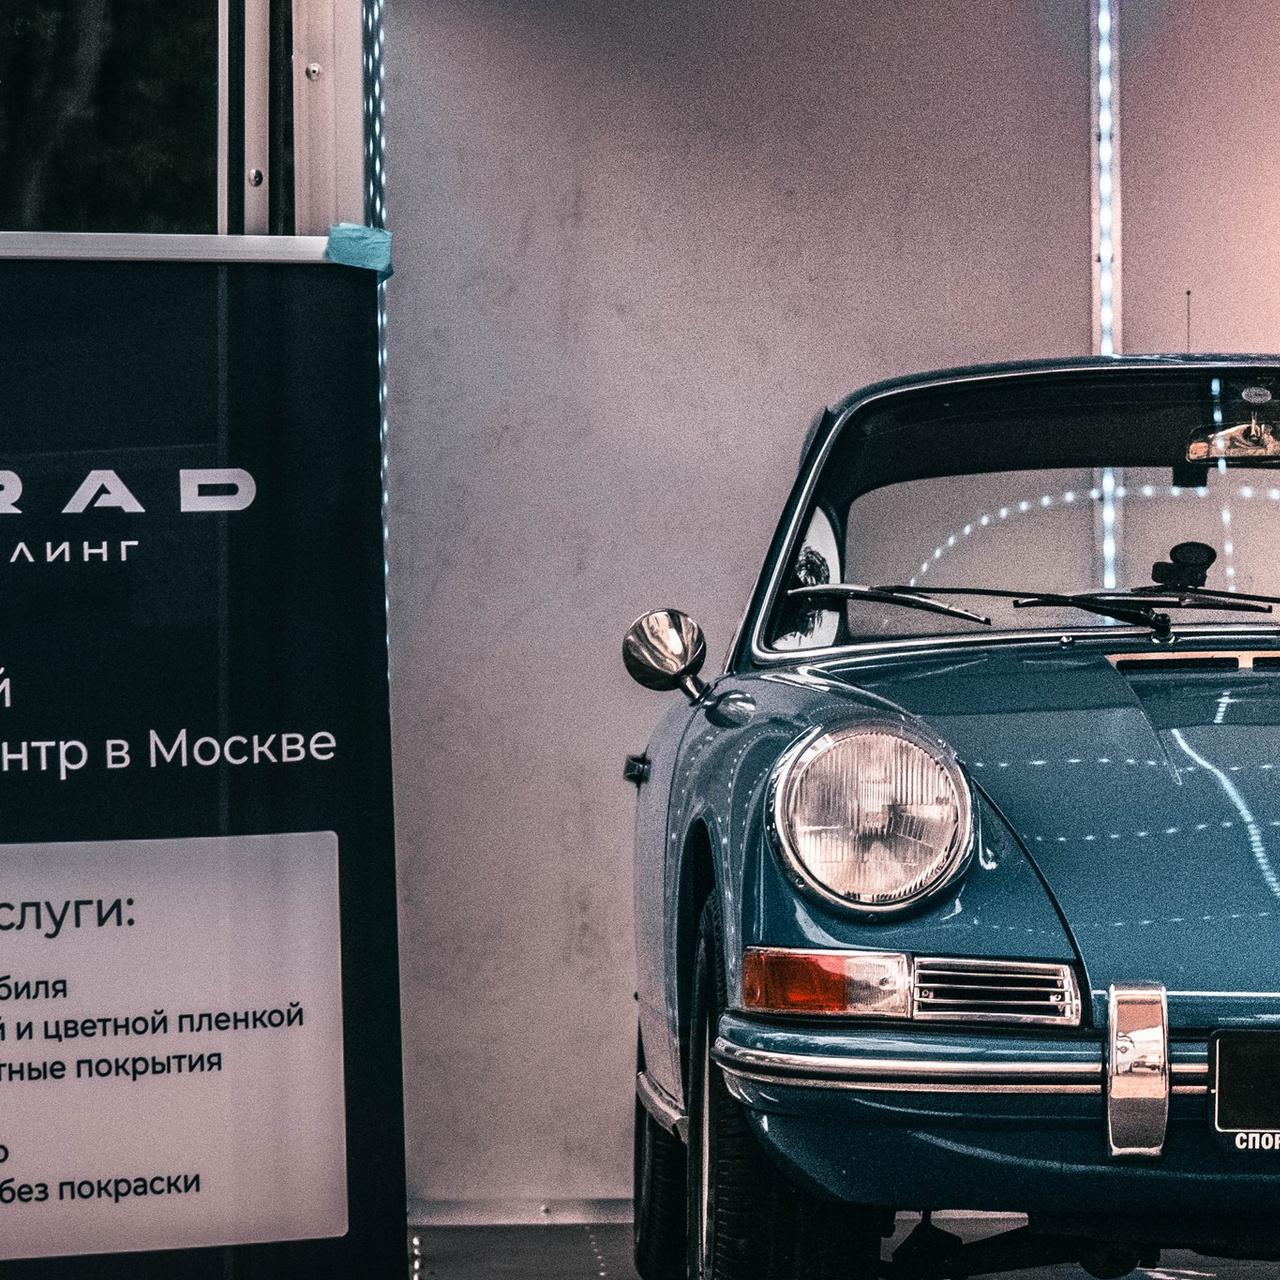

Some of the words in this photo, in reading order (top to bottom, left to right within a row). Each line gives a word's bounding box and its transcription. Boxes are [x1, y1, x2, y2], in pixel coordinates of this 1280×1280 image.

[0, 468, 257, 514] AD
[9, 540, 139, 563] ЛИНГ
[1, 740, 88, 781] нтр
[105, 739, 131, 769] в
[149, 728, 337, 768] Москве
[0, 897, 135, 940] слуги:
[0, 974, 68, 1001] биля
[16, 1021, 34, 1041] и
[43, 1009, 168, 1042] цветной
[178, 1001, 304, 1033] пленкой
[76, 1051, 222, 1082] покрытия
[0, 1177, 49, 1205] без
[58, 1173, 201, 1204] покраски
